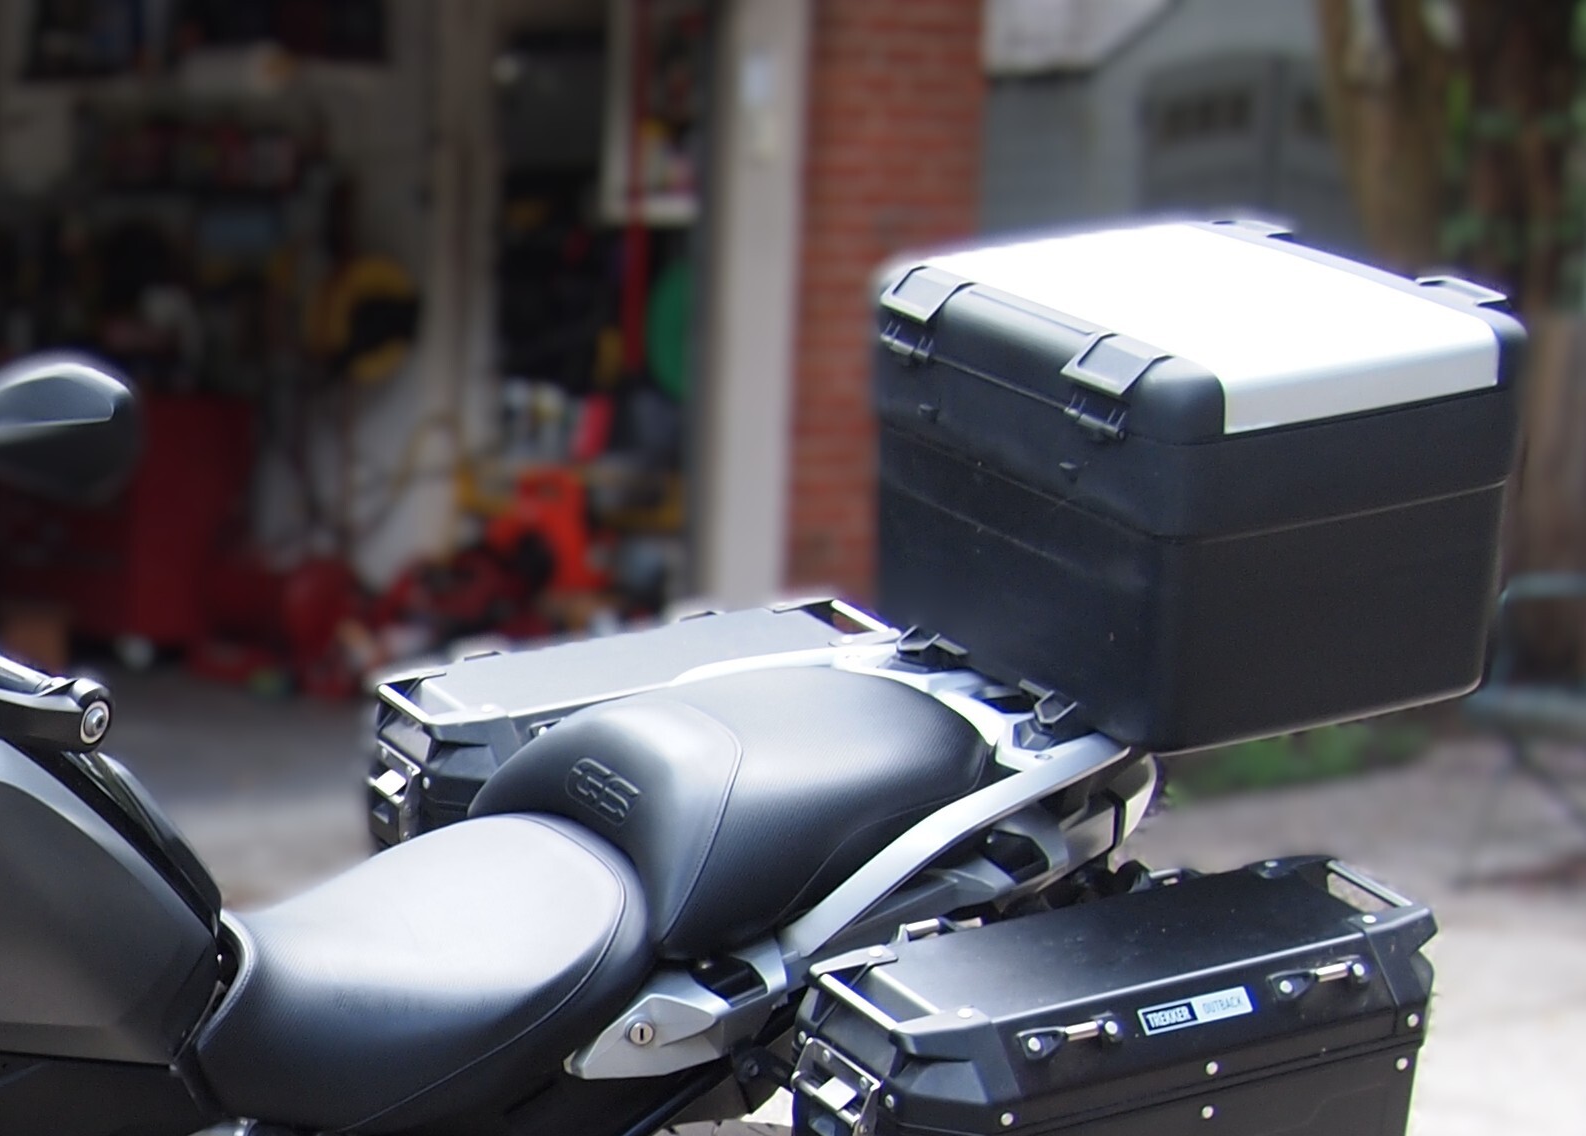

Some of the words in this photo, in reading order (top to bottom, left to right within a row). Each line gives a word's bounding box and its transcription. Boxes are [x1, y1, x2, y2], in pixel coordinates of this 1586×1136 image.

[569, 757, 641, 821] GS
[1146, 1005, 1192, 1029] TREKKER
[1201, 995, 1243, 1015] OUTBACK
